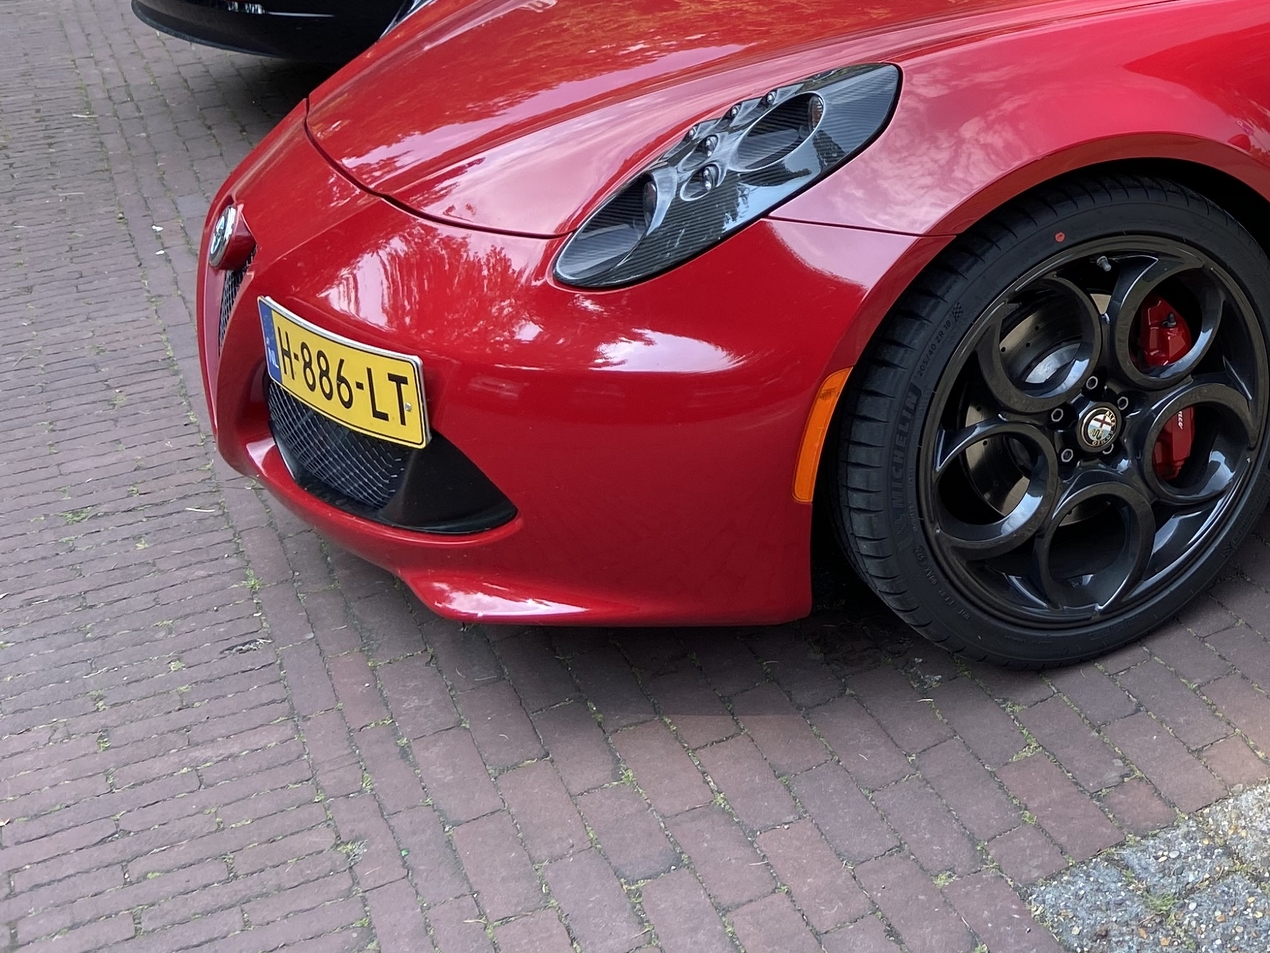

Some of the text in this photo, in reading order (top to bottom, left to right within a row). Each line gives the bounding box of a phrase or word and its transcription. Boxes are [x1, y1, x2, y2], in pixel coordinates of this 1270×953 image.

[277, 326, 409, 426] H-886-LT
[917, 343, 937, 377] 205/40
[934, 330, 944, 344] ZR
[890, 390, 919, 510] MICHELIN
